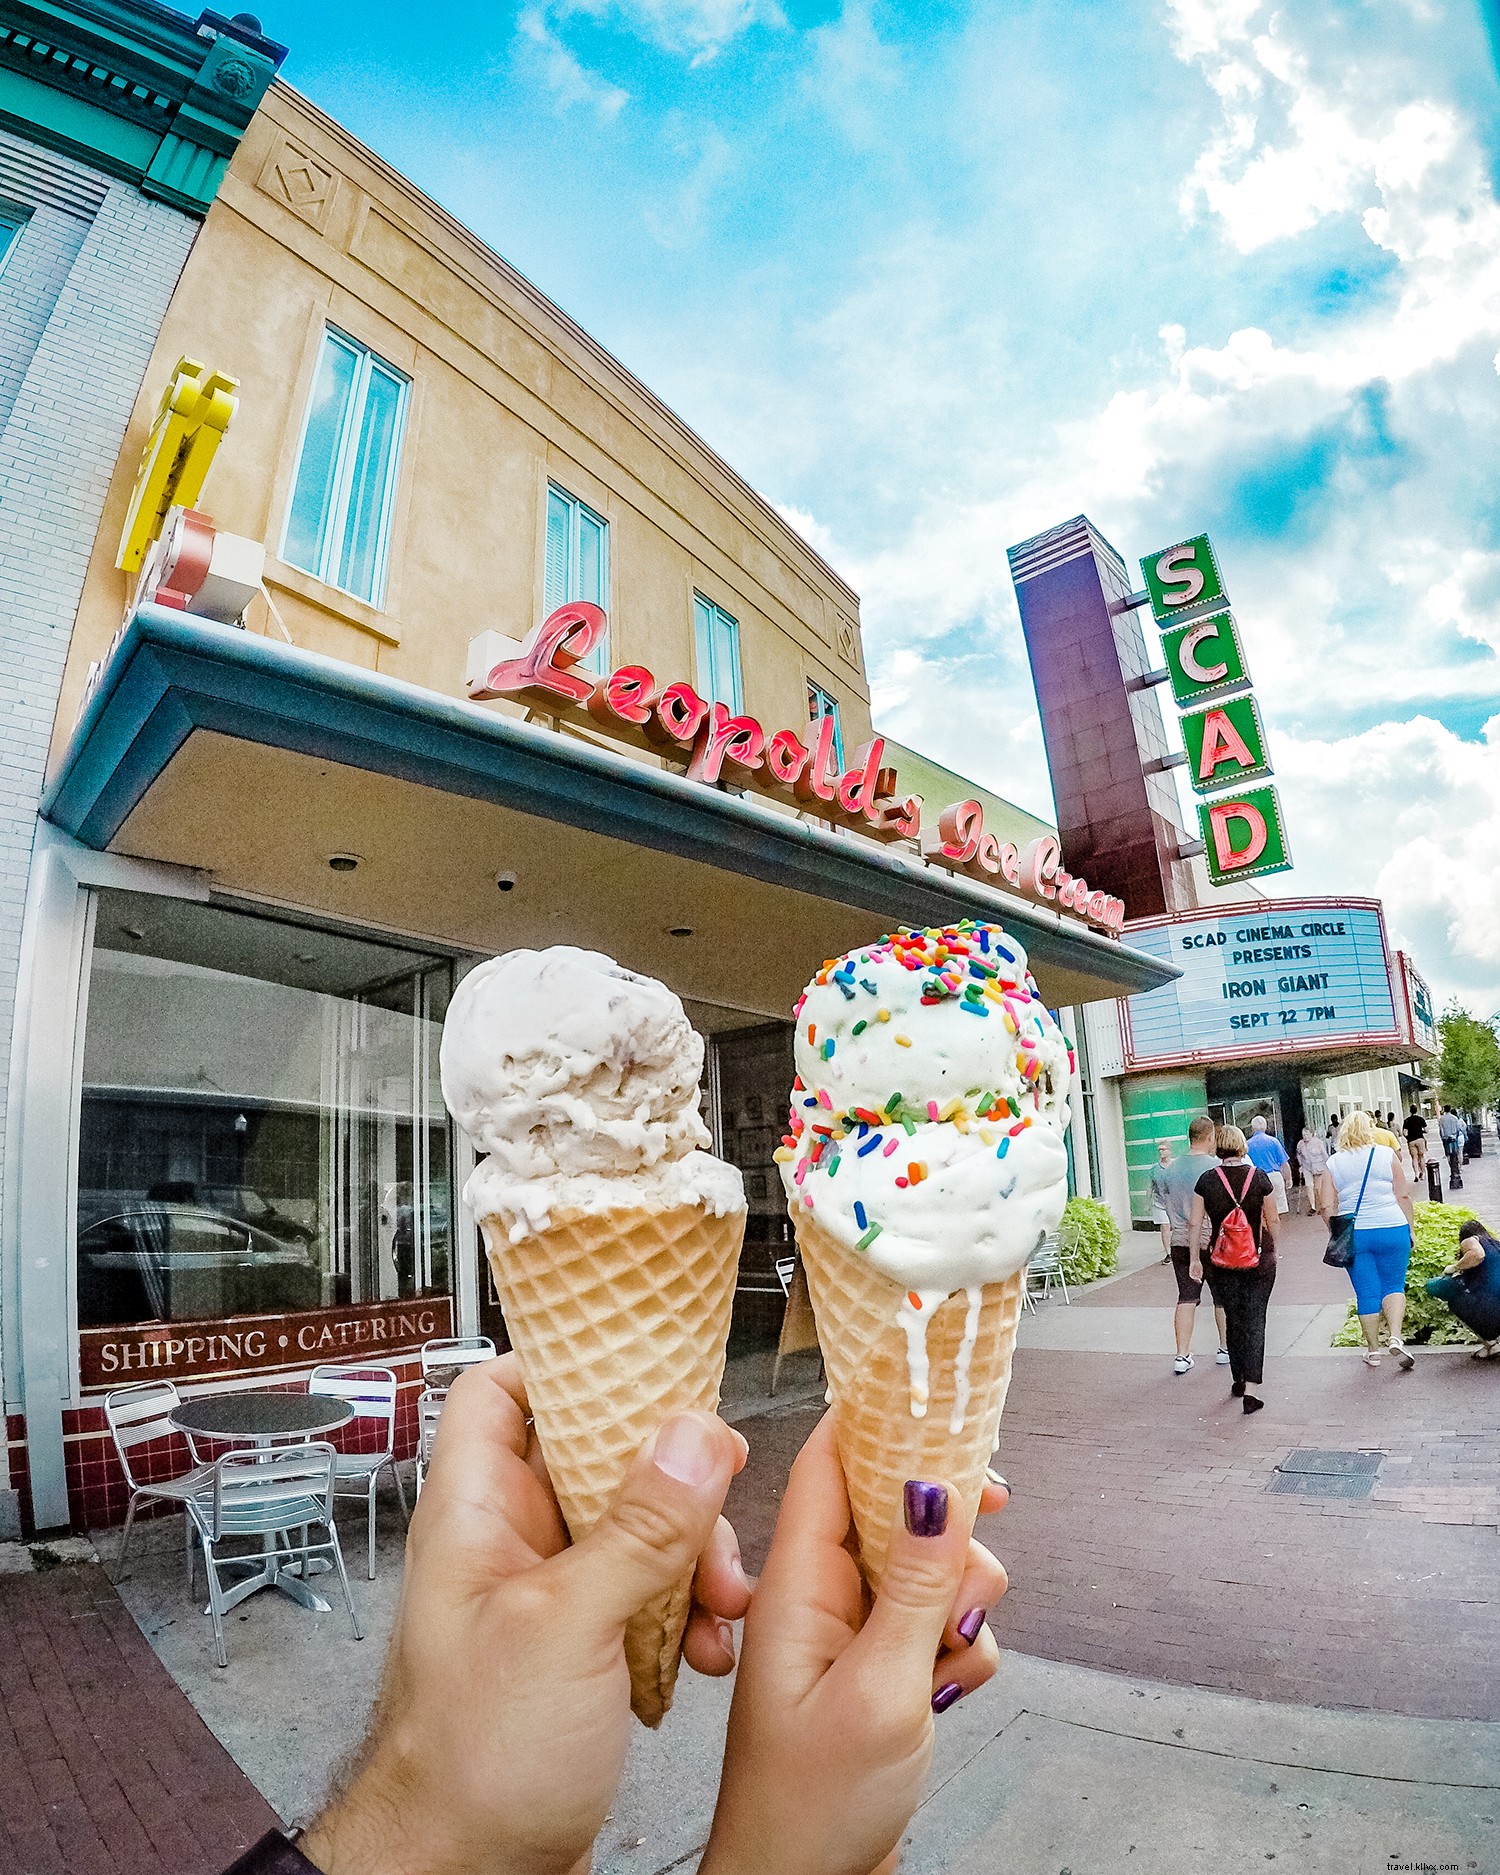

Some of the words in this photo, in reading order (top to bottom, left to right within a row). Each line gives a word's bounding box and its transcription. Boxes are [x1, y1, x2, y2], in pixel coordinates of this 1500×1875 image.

[1155, 544, 1268, 871] SCAD
[939, 799, 1021, 889] Ice
[1032, 835, 1125, 932] Cream
[1182, 931, 1227, 950] SCAD
[1235, 924, 1294, 944] CINEMA
[1300, 922, 1346, 938] CIRCLE
[1232, 945, 1312, 965] PRESENTS
[1222, 979, 1266, 999] IRON
[1278, 973, 1329, 993] GIANT
[1229, 1011, 1270, 1029] SEPT
[1278, 1010, 1297, 1025] 22
[1307, 1006, 1336, 1021] 7PM
[100, 1330, 267, 1373] SHIPPING
[297, 1311, 436, 1351] CATERING
